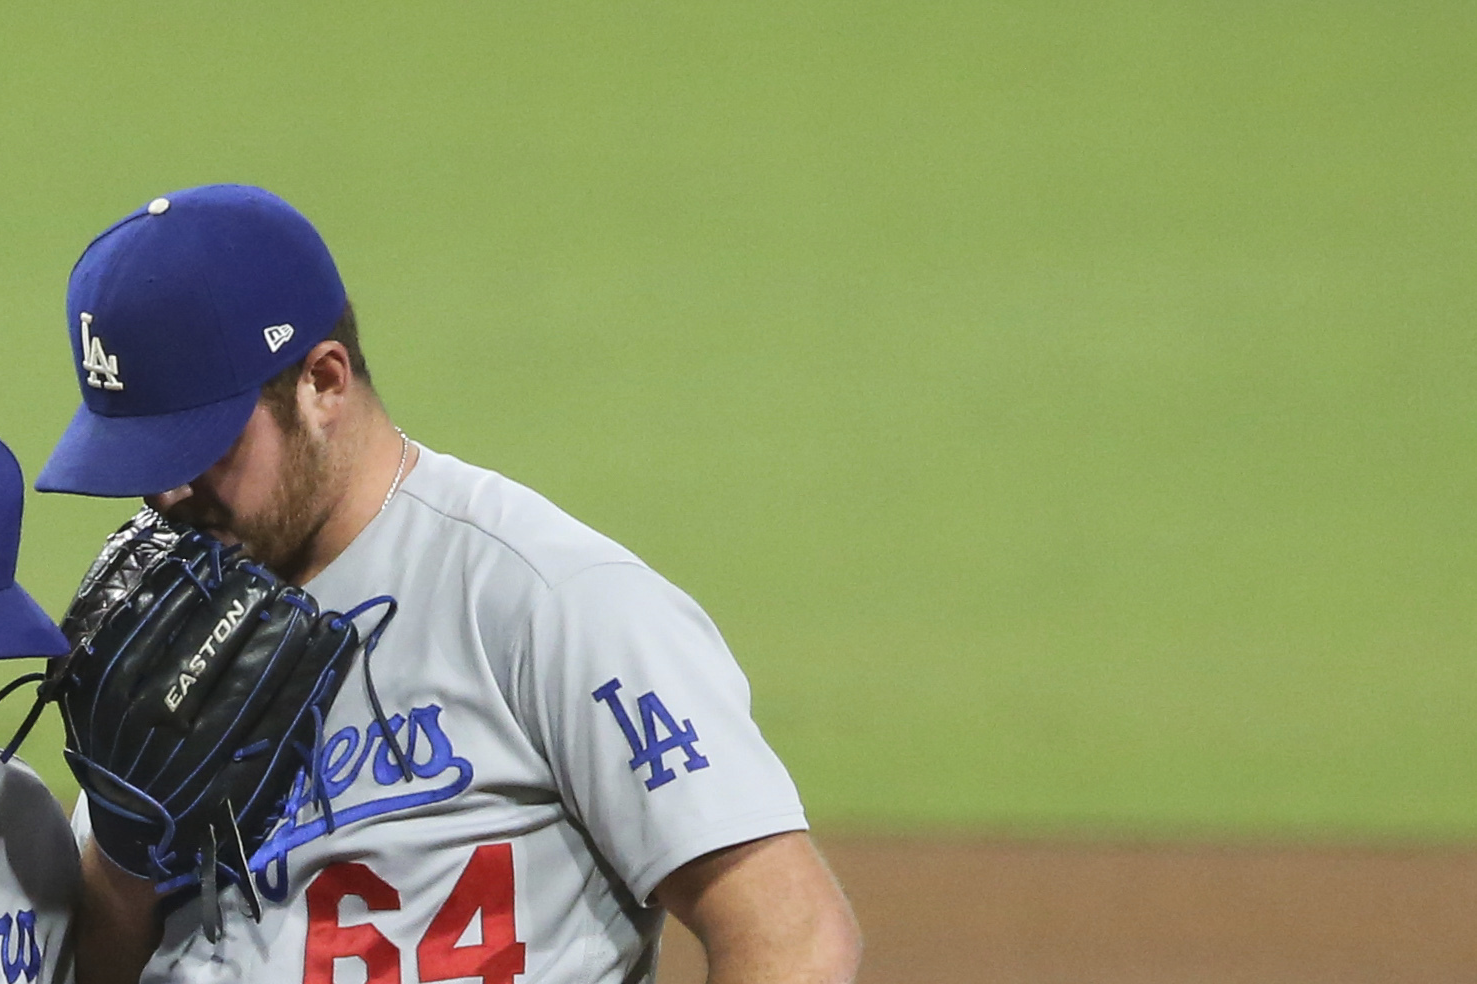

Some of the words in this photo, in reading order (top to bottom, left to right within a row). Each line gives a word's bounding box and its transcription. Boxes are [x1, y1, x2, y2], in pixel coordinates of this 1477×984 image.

[79, 312, 124, 391] LA
[163, 599, 248, 713] EASTON
[591, 677, 711, 792] LA
